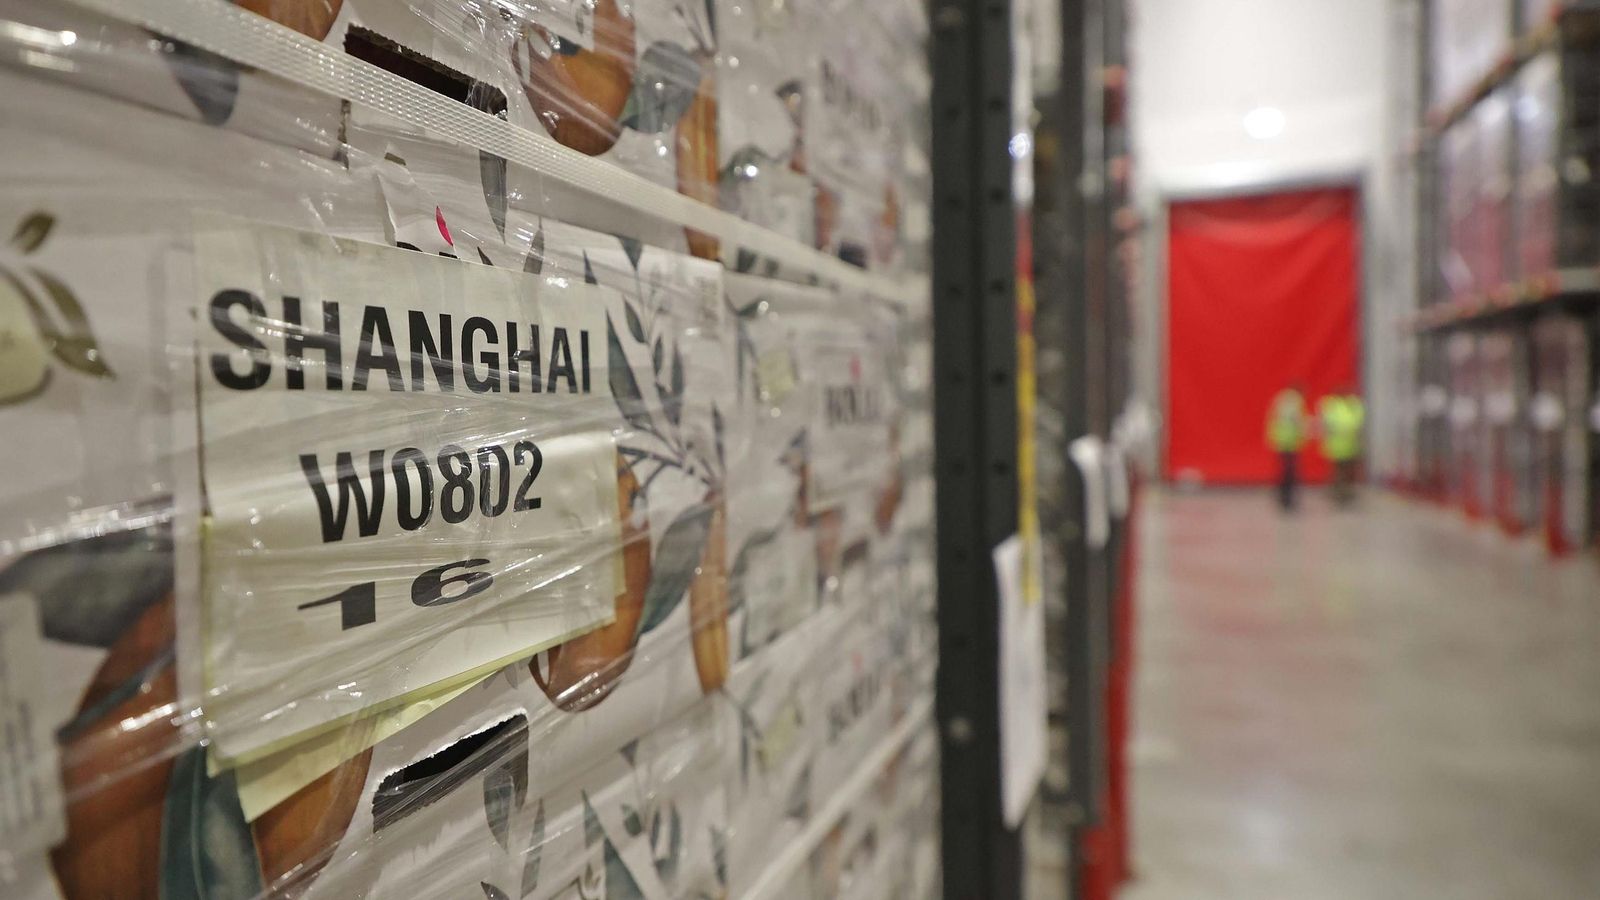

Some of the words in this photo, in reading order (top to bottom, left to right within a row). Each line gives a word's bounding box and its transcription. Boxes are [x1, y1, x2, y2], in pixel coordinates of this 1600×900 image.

[210, 289, 590, 394] SHANGHAI
[299, 441, 542, 543] W0802
[297, 558, 493, 630] 16
